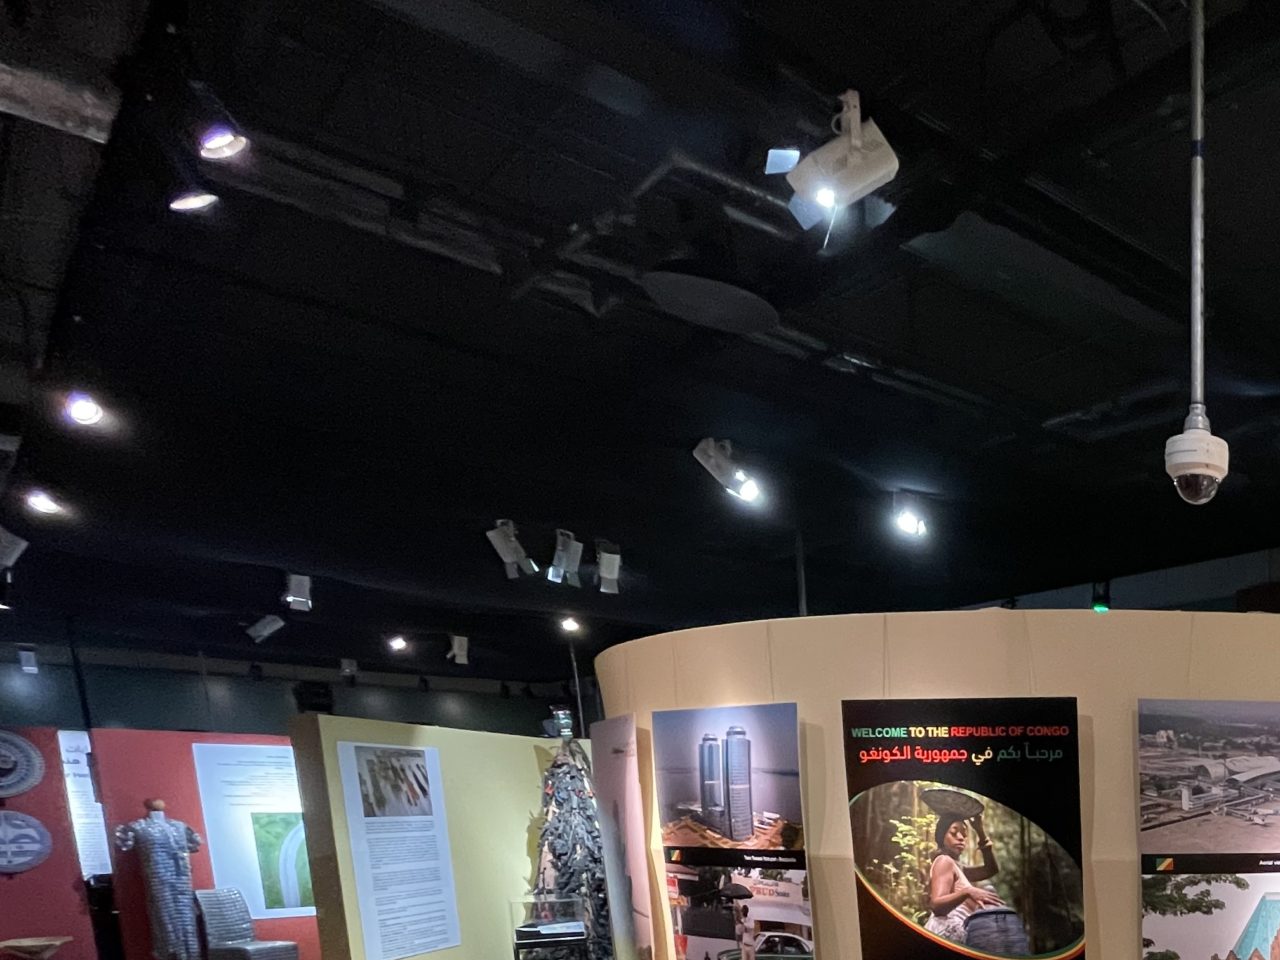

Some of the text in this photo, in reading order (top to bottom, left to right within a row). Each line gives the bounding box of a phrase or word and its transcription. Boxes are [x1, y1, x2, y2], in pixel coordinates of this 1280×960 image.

[851, 726, 1070, 738] WELCOME TO THE REPUBLIC OF CONGO
[859, 745, 911, 763] الكونغو
[914, 745, 968, 763] جمهورية
[971, 747, 993, 765] في
